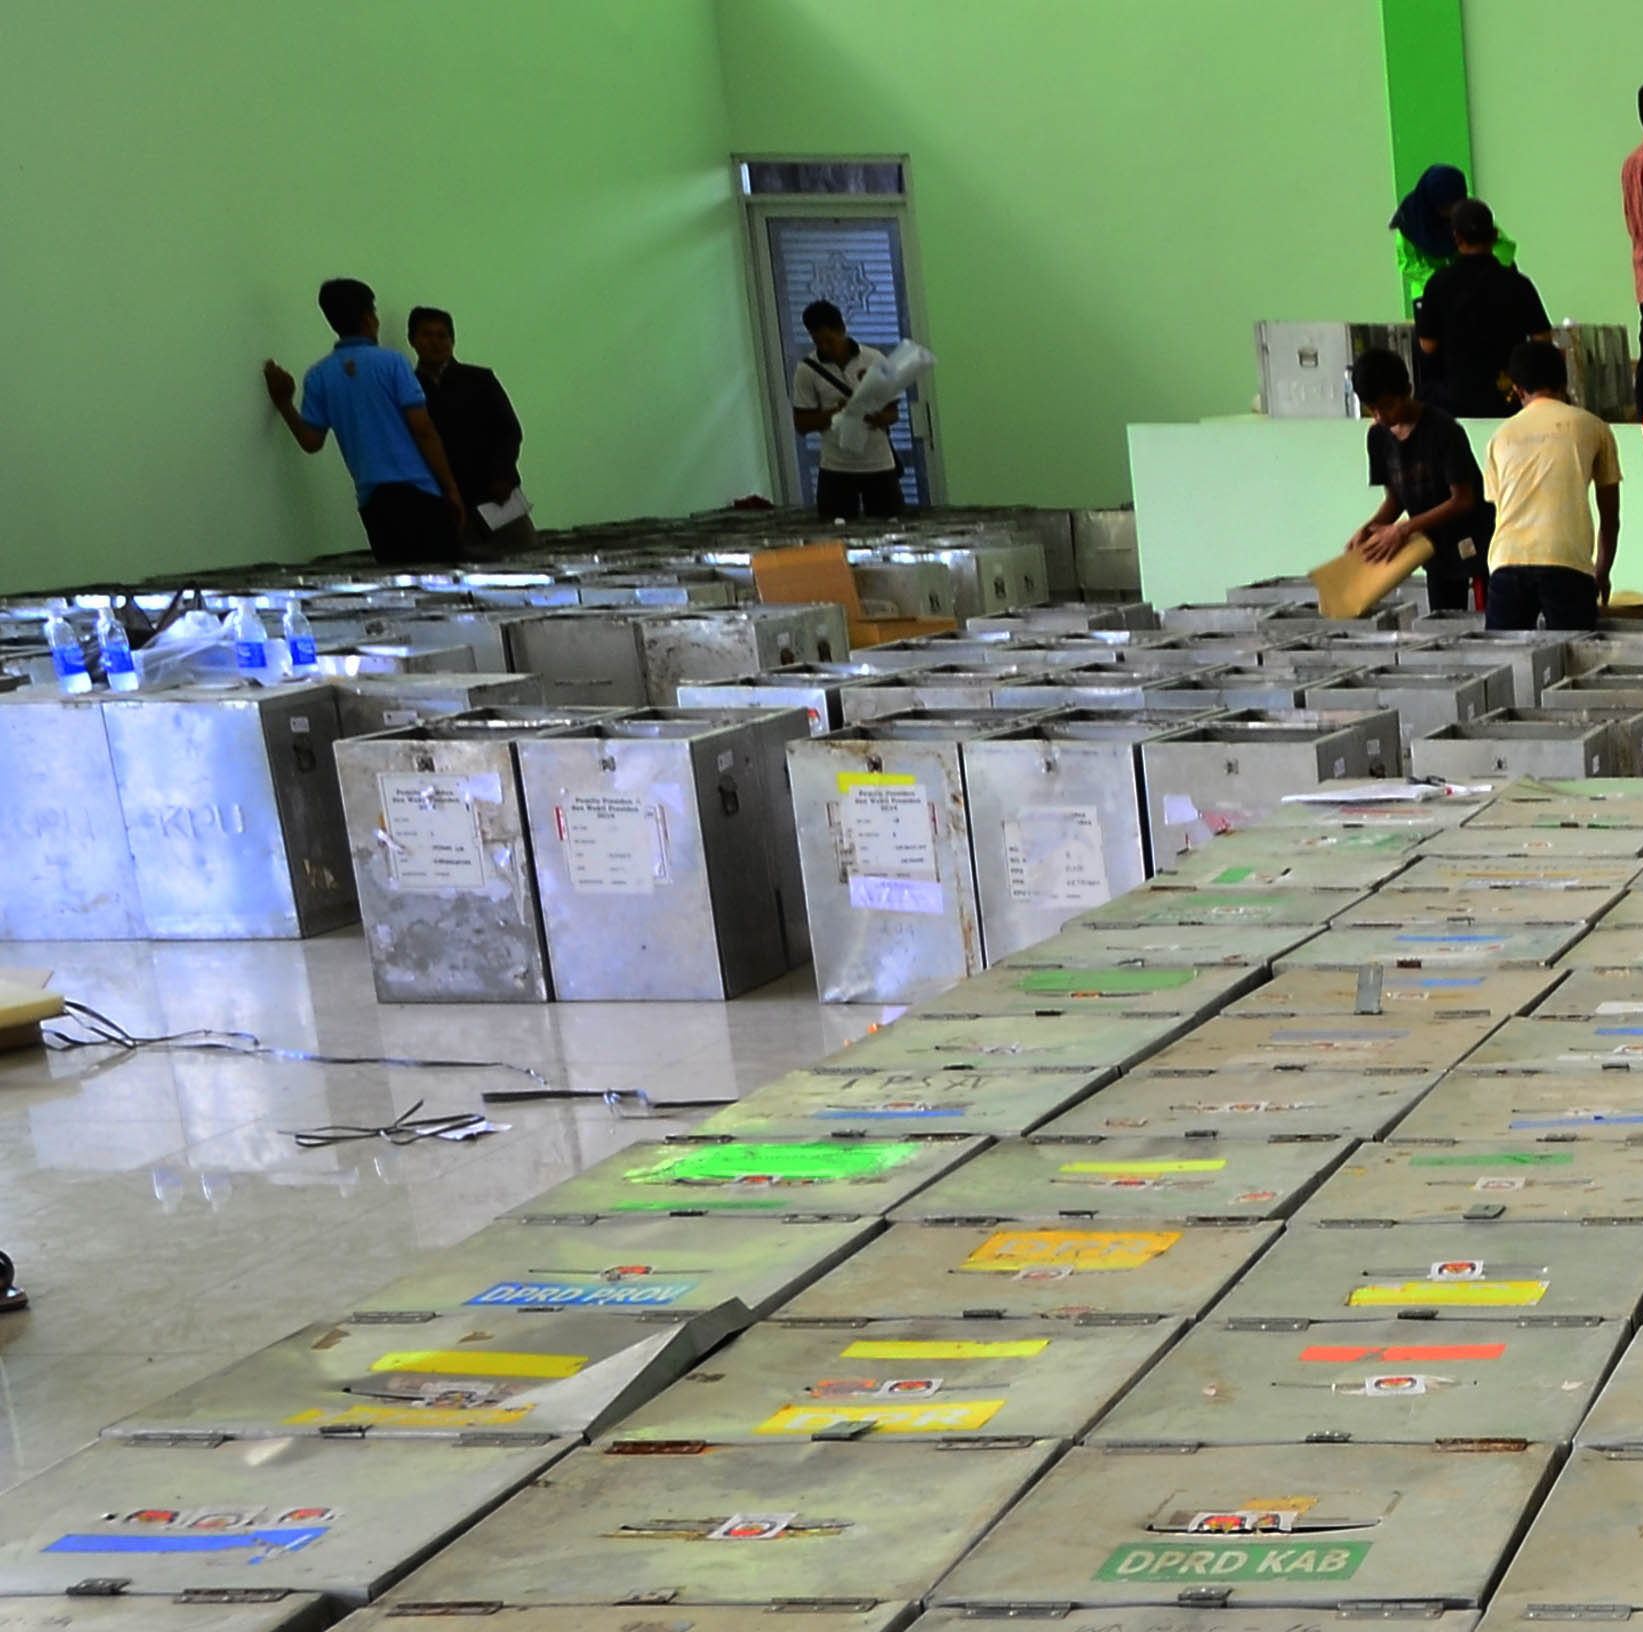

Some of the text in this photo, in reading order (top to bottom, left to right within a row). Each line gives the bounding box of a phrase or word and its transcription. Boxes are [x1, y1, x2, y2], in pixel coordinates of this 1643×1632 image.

[478, 1285, 692, 1304] DPRD PROV
[1115, 1547, 1352, 1578] DPRD KAB
